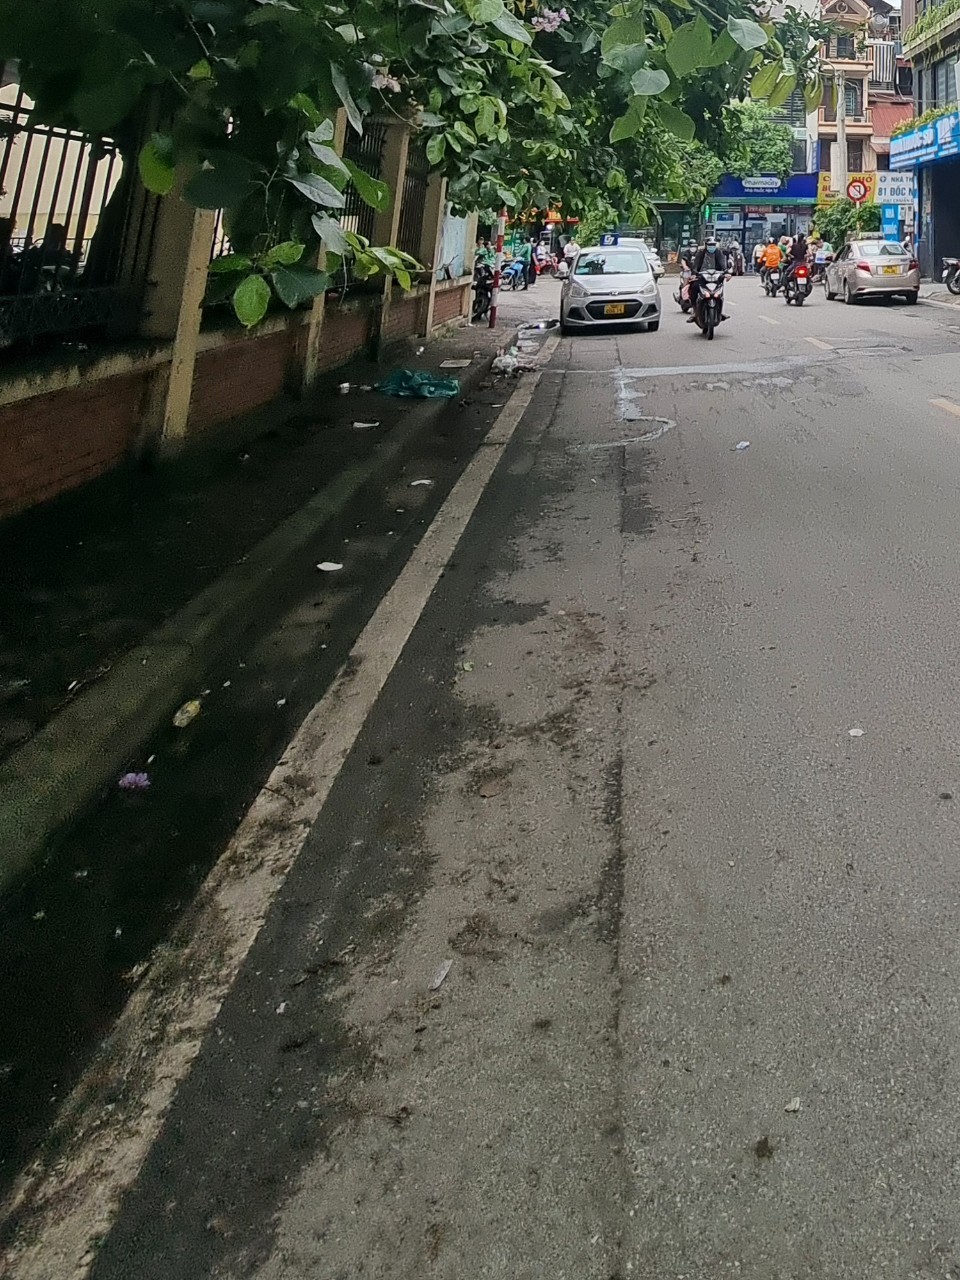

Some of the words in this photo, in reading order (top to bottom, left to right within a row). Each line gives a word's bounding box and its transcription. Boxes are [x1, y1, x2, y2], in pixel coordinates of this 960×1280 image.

[744, 178, 779, 188] Pharmacity
[890, 175, 904, 183] NHÀ
[877, 186, 887, 196] 81
